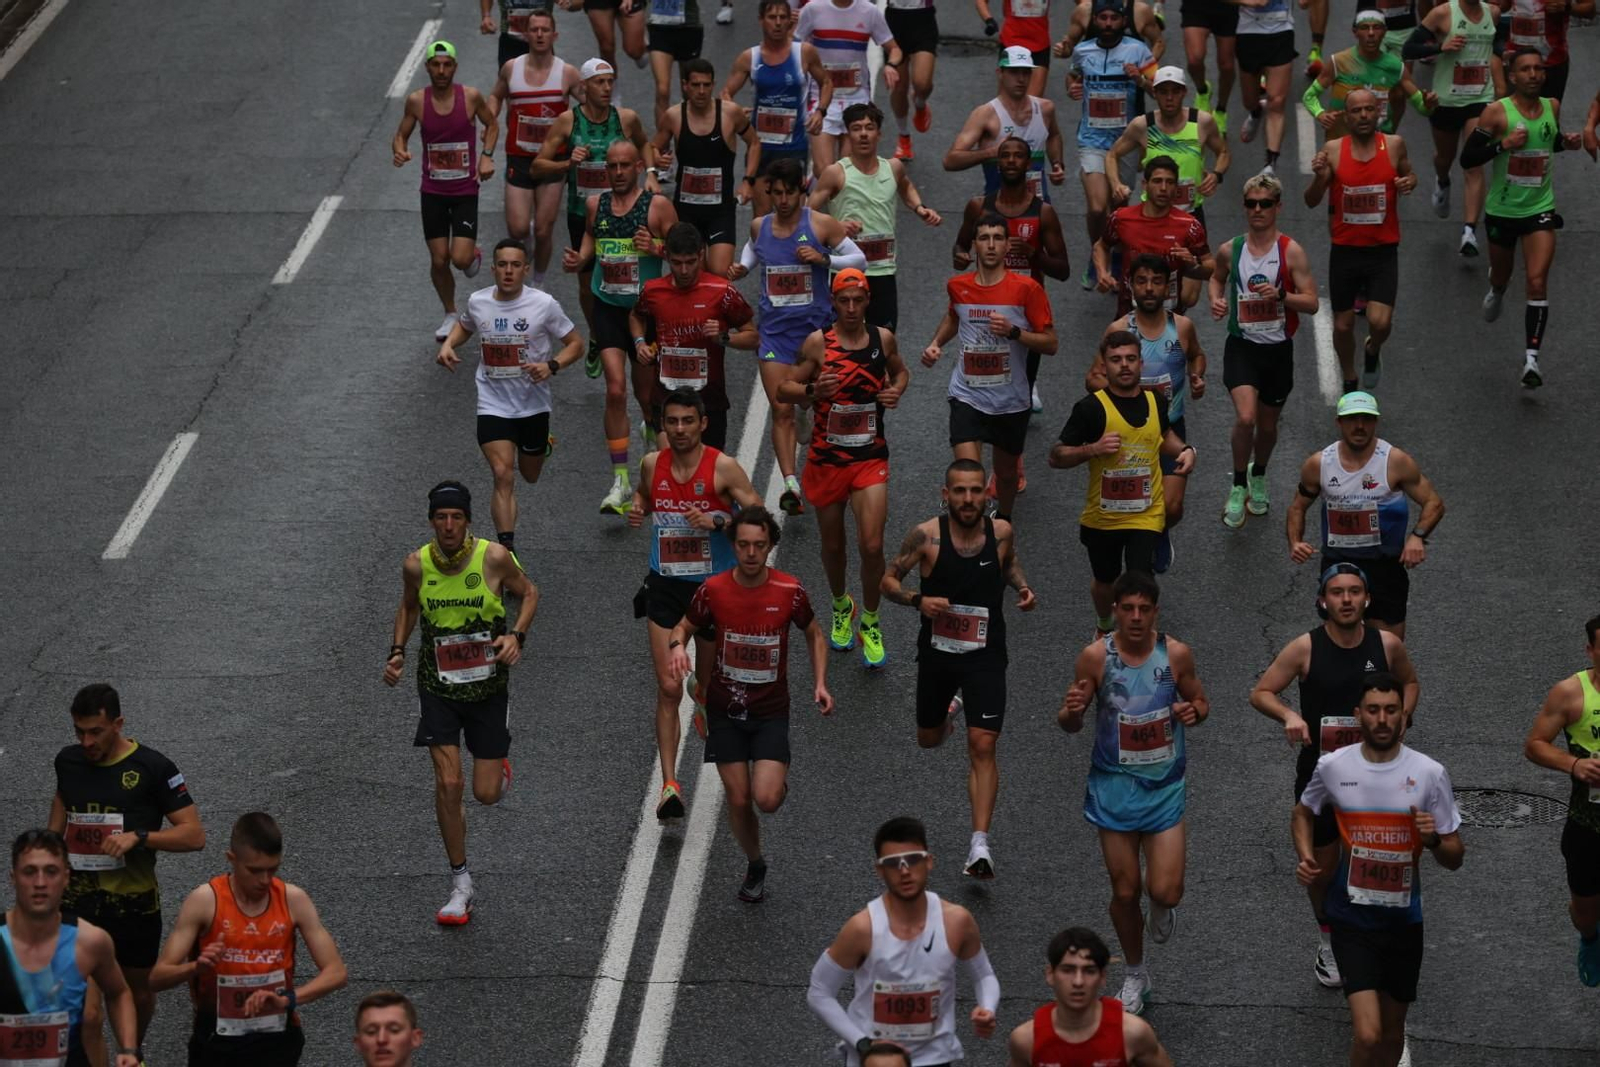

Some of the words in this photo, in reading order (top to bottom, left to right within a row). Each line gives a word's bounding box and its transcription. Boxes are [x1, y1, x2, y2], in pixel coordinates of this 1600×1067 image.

[777, 276, 797, 290] 454
[664, 539, 698, 554] 1298
[426, 596, 484, 611] DEPORTEMANIA
[944, 615, 970, 632] 209
[445, 645, 480, 663] 1420
[733, 646, 768, 663] 1268
[1359, 861, 1400, 882] 1403
[884, 996, 926, 1014] 1093
[11, 1030, 48, 1049] 239
